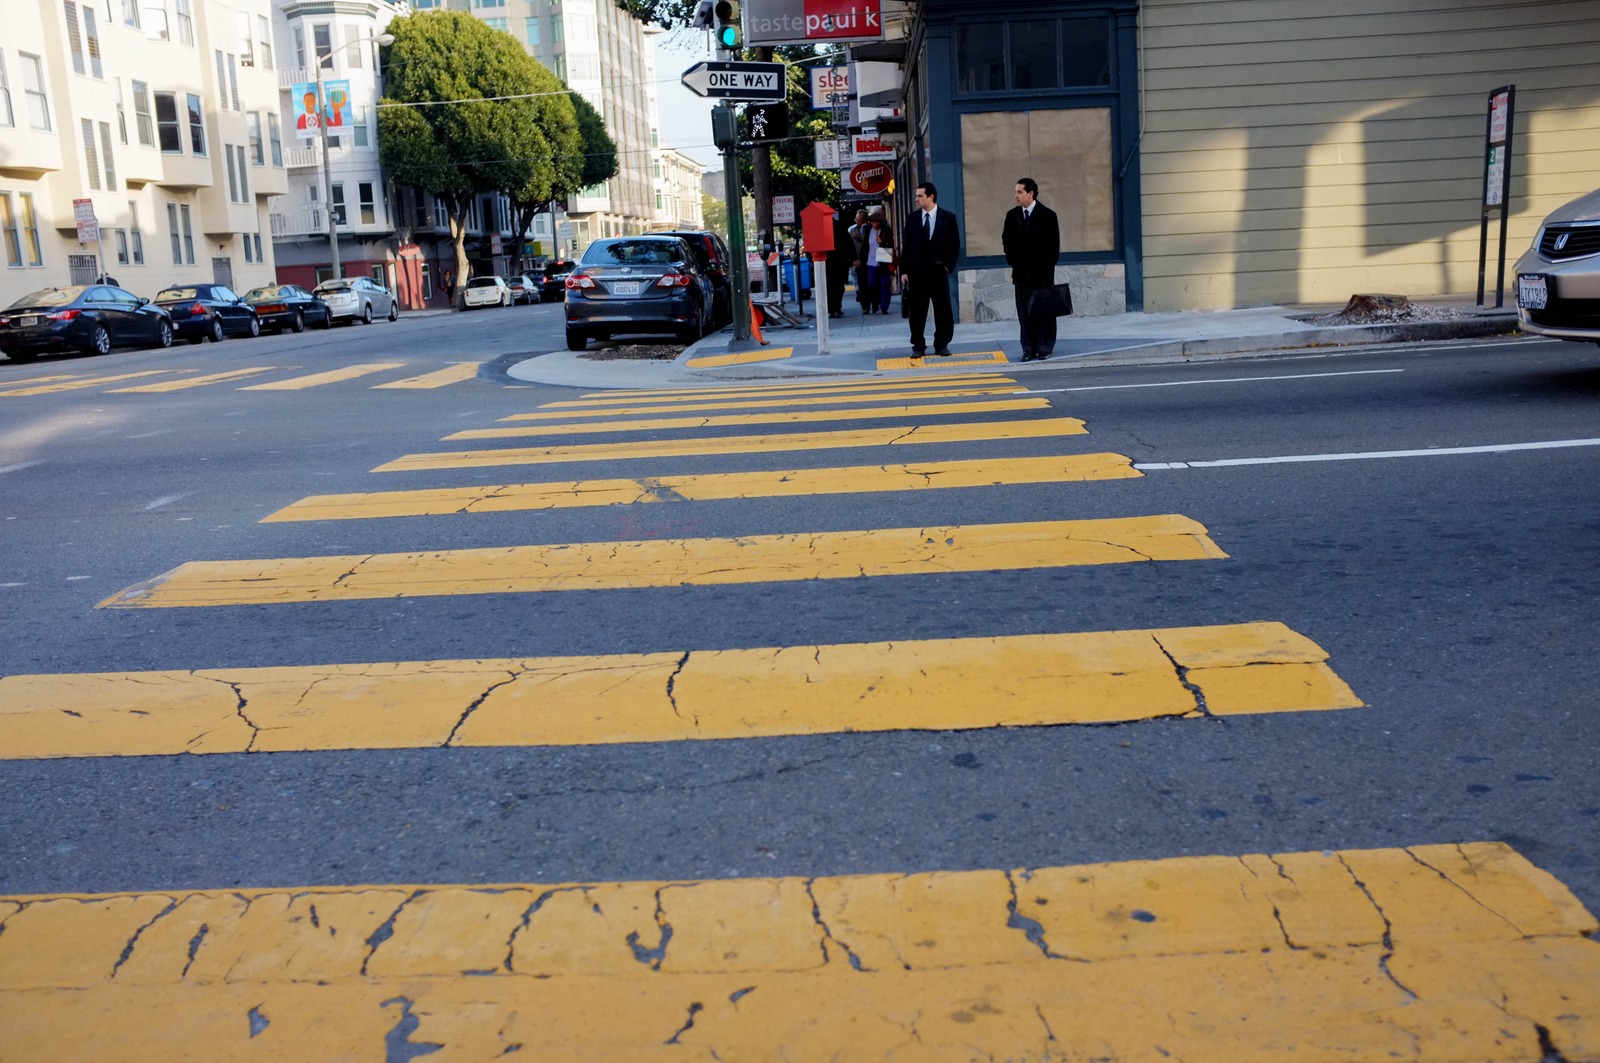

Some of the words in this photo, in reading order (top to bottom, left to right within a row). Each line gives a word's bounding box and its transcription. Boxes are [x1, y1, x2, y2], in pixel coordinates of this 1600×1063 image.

[865, 6, 879, 27] k
[709, 72, 738, 87] ONE
[744, 73, 773, 88] WAY
[856, 137, 893, 153] insi
[1489, 150, 1495, 163] 2
